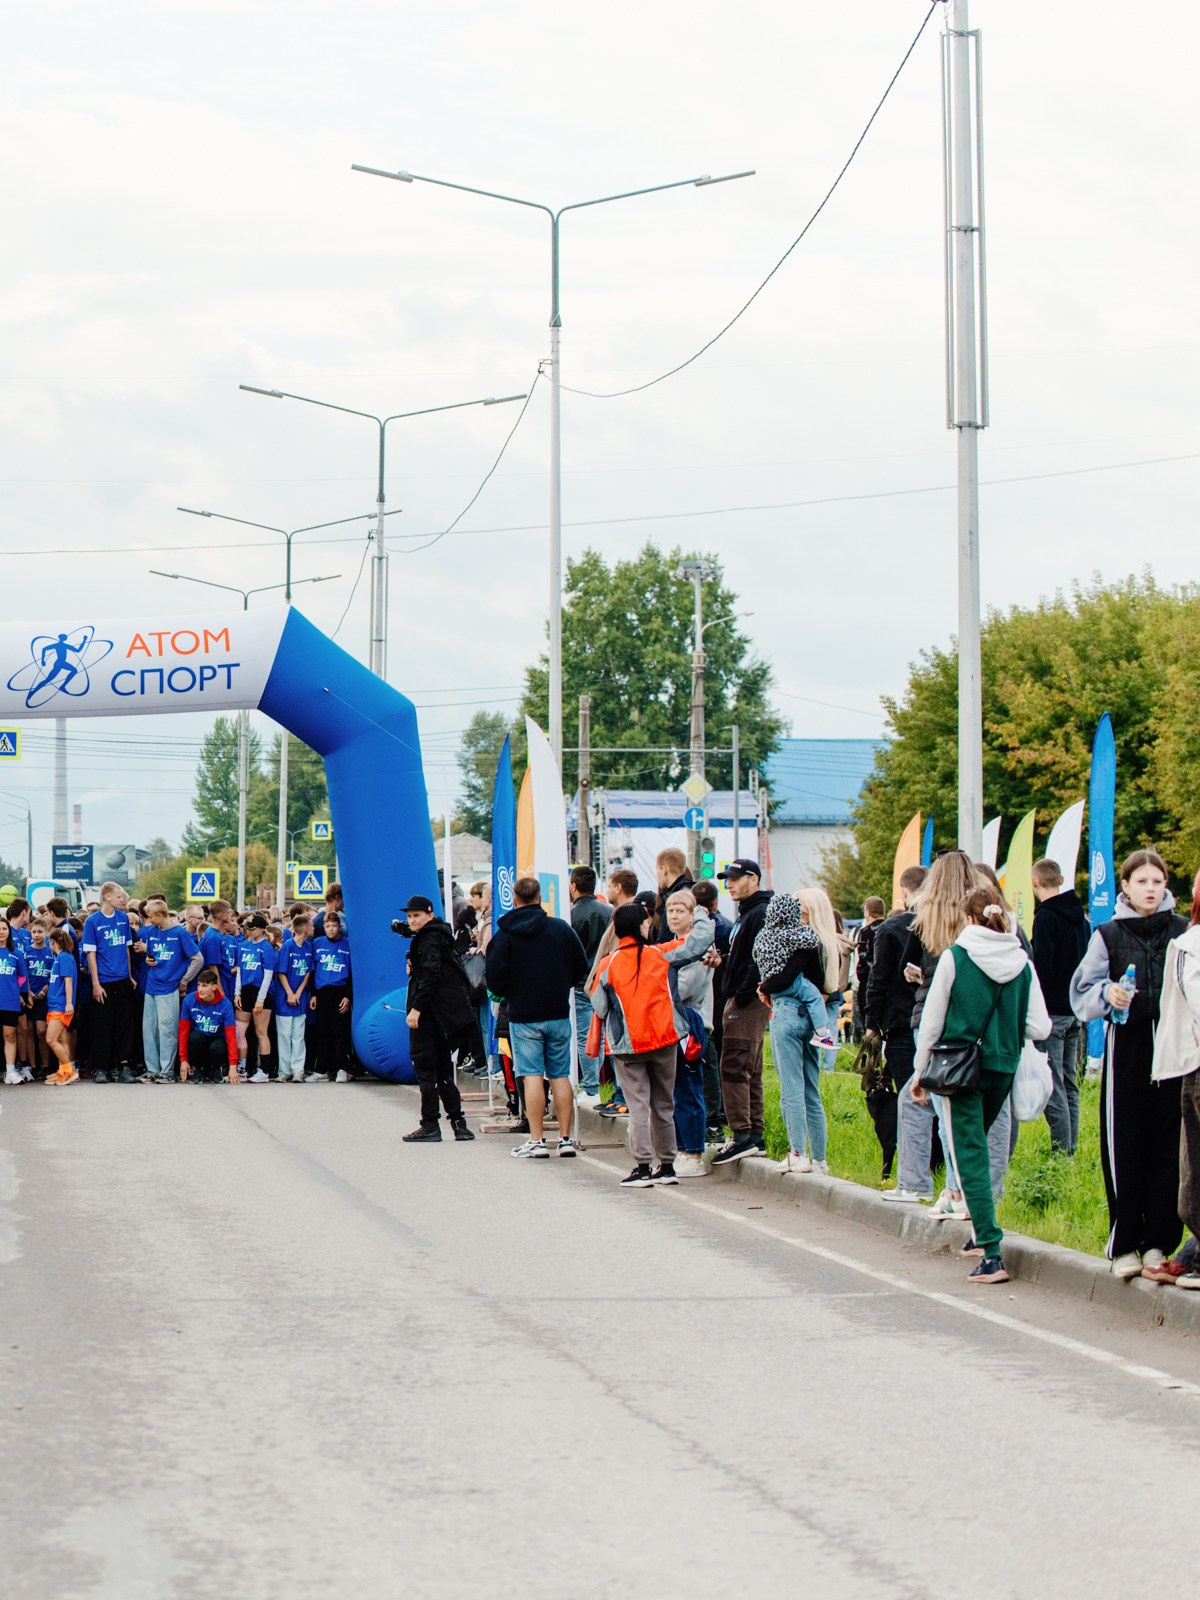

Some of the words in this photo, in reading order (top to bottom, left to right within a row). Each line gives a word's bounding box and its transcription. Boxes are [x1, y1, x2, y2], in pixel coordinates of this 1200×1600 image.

[126, 627, 230, 658] АТОМ
[111, 662, 241, 696] СПОРТ
[327, 962, 345, 972] БЕГ
